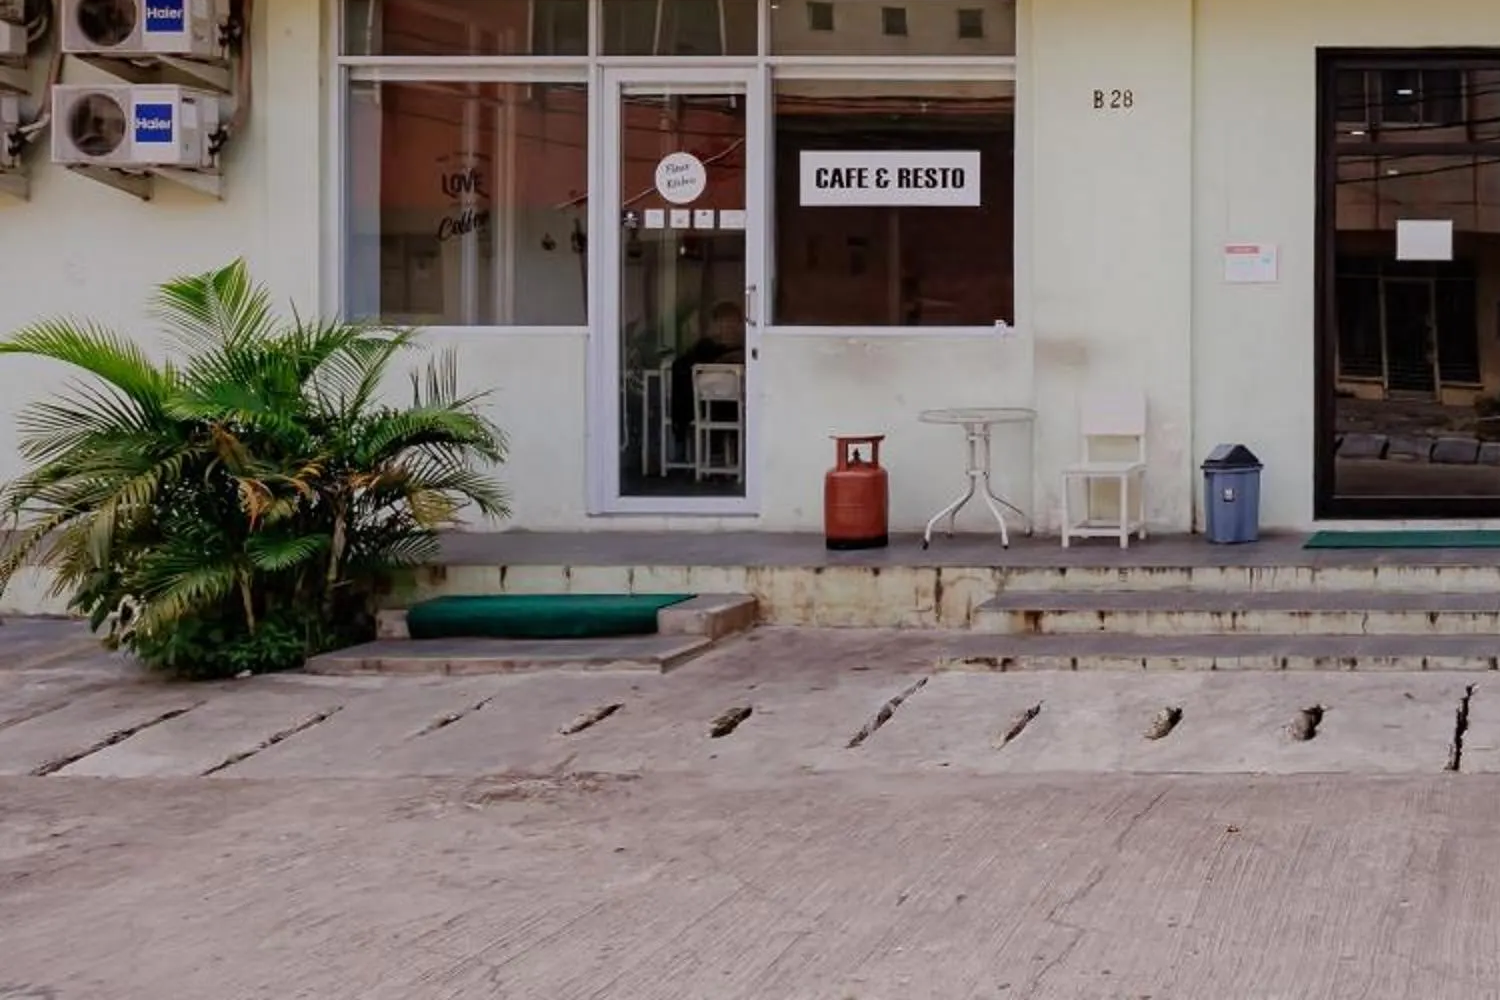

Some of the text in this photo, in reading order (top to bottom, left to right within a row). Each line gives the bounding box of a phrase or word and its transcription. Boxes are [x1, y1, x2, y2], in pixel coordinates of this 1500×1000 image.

[147, 7, 184, 20] Haier
[1093, 89, 1133, 109] B 28
[135, 117, 172, 130] Haier
[815, 167, 965, 189] CAFE & RESTO
